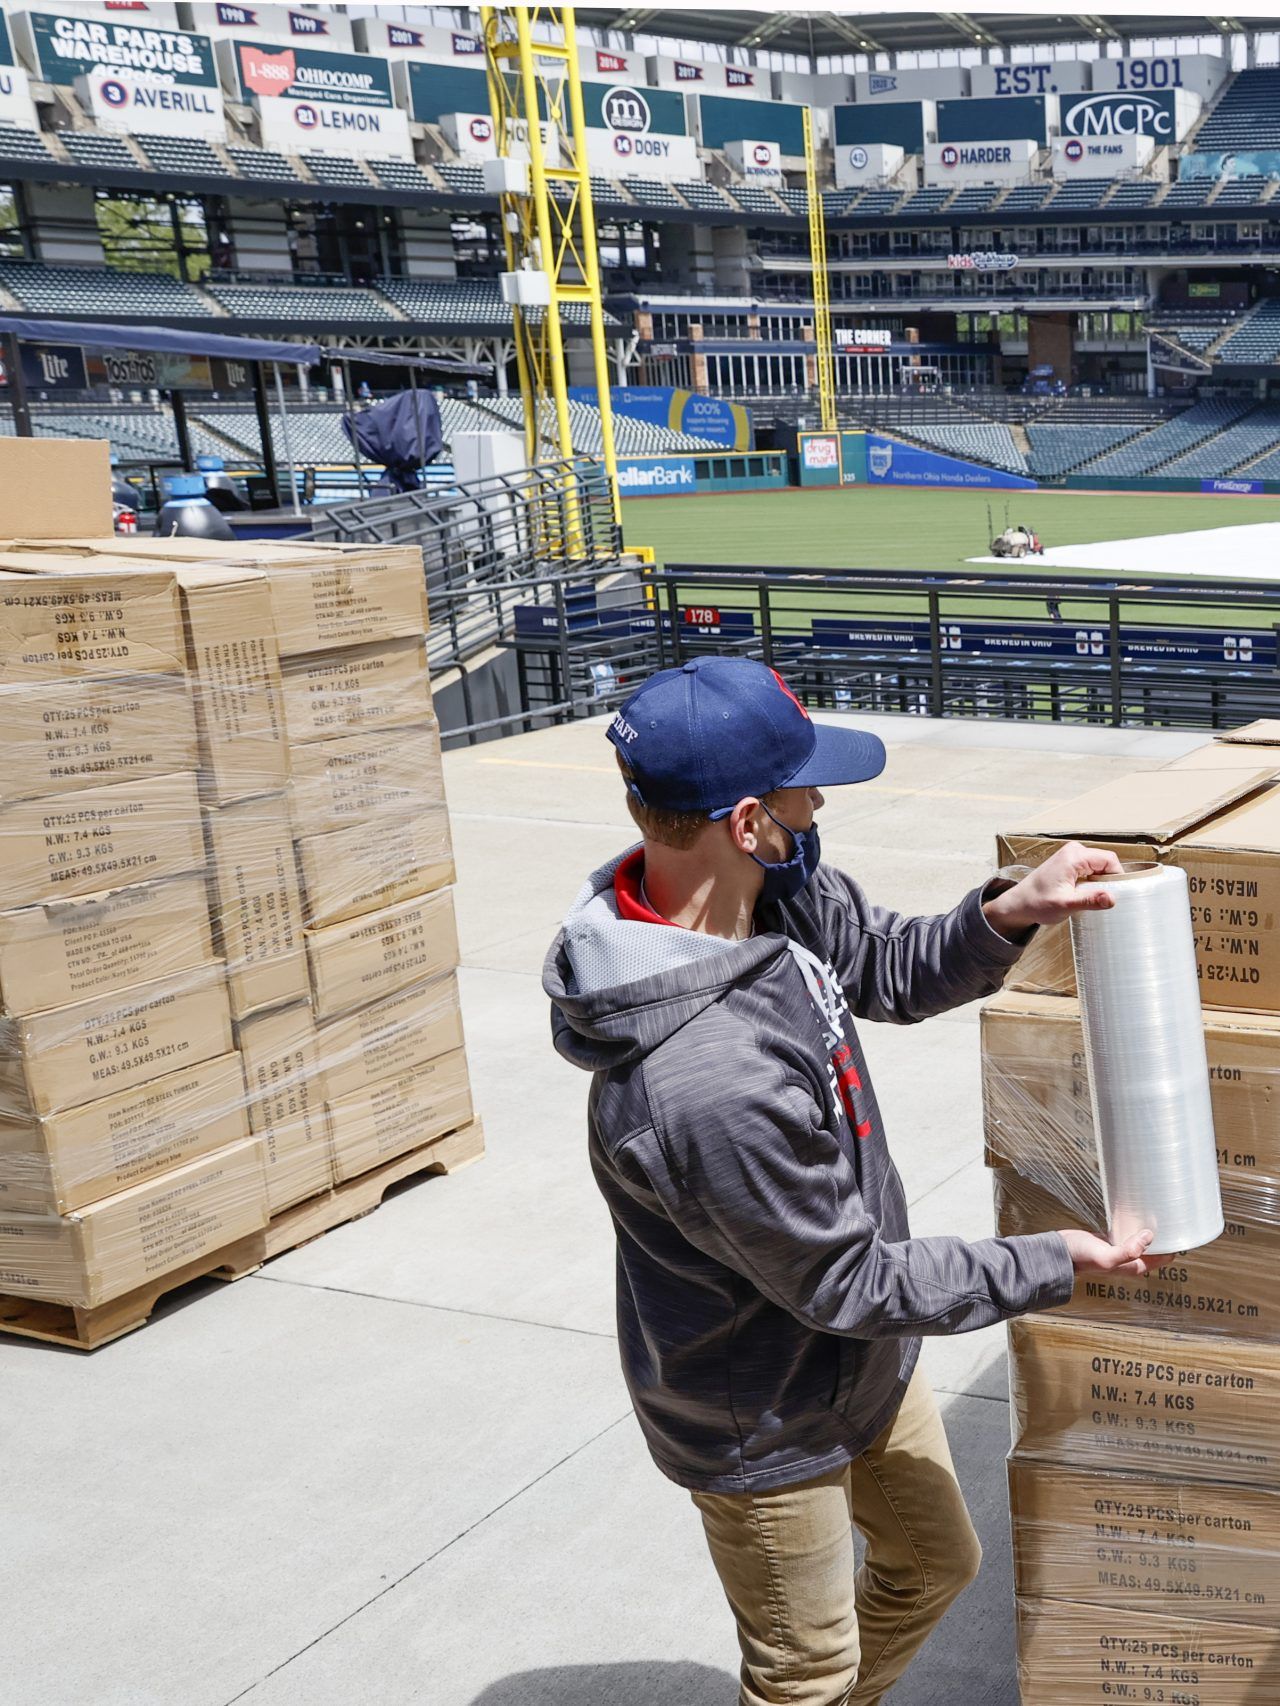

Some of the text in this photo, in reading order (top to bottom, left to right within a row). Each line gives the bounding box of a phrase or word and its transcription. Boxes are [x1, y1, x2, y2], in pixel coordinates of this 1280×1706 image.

[293, 17, 316, 32] 1999
[54, 18, 194, 55] CAR PARTS
[390, 30, 412, 44] 2001
[50, 36, 204, 75] WAREHOUSE
[600, 56, 619, 69] 2016
[250, 62, 374, 90] 1-888 OHIOCOMP
[995, 58, 1183, 94] EST. 1901
[107, 86, 215, 114] 3 AVERILL
[320, 110, 380, 132] LEMON
[635, 140, 670, 157] DOBY
[960, 147, 1011, 164] HARDER
[1088, 145, 1123, 156] THE FANS
[948, 254, 972, 269] kids
[834, 328, 892, 346] THE CORNER
[40, 352, 69, 384] Lite
[224, 362, 246, 388] Lite
[692, 402, 721, 415] 100%
[806, 444, 832, 457] drug
[809, 452, 838, 464] mart
[892, 471, 991, 484] Northern Ohio Honda Dealers
[1214, 480, 1252, 492] FirstEnergy
[23, 592, 122, 608] MEAS: 49.5X49.5X21
[55, 610, 123, 624] G.W.: KGS
[690, 608, 714, 624] 178
[58, 628, 126, 643] N.W.: KGS
[22, 648, 101, 664] PCS carton
[43, 802, 144, 828] QTY:25 carton
[46, 826, 112, 846] N.W.: KGS
[94, 844, 114, 856] KGS
[82, 856, 142, 878] 49.5X49.5X21
[1210, 877, 1258, 898] MEAS:
[1220, 909, 1258, 926] G.W.:
[1220, 939, 1258, 956] N.W.:
[1207, 964, 1260, 984] QTY:25
[129, 1020, 147, 1033] KGS
[89, 1036, 150, 1064] G.W.: KGS
[92, 1046, 176, 1082] MEAS: 49.5X49.5X21
[1234, 1152, 1256, 1167] cm
[1158, 1268, 1188, 1282] KGS
[1086, 1282, 1258, 1318] MEAS: 49.5X49.5X21 cm
[1092, 1356, 1254, 1390] QTY:25 PCS per carton
[1091, 1384, 1196, 1412] N.W.: 7.4 KGS
[1092, 1410, 1196, 1436] G.W.: 9.3 KGS
[1094, 1500, 1252, 1532] QTY:25 PCS per carton
[1097, 1549, 1196, 1573] G.W.: 9.3 KGS
[1098, 1572, 1266, 1604] MEAS: 49.5X49.5X21 cm
[1100, 1635, 1254, 1669] QTY:25 carton
